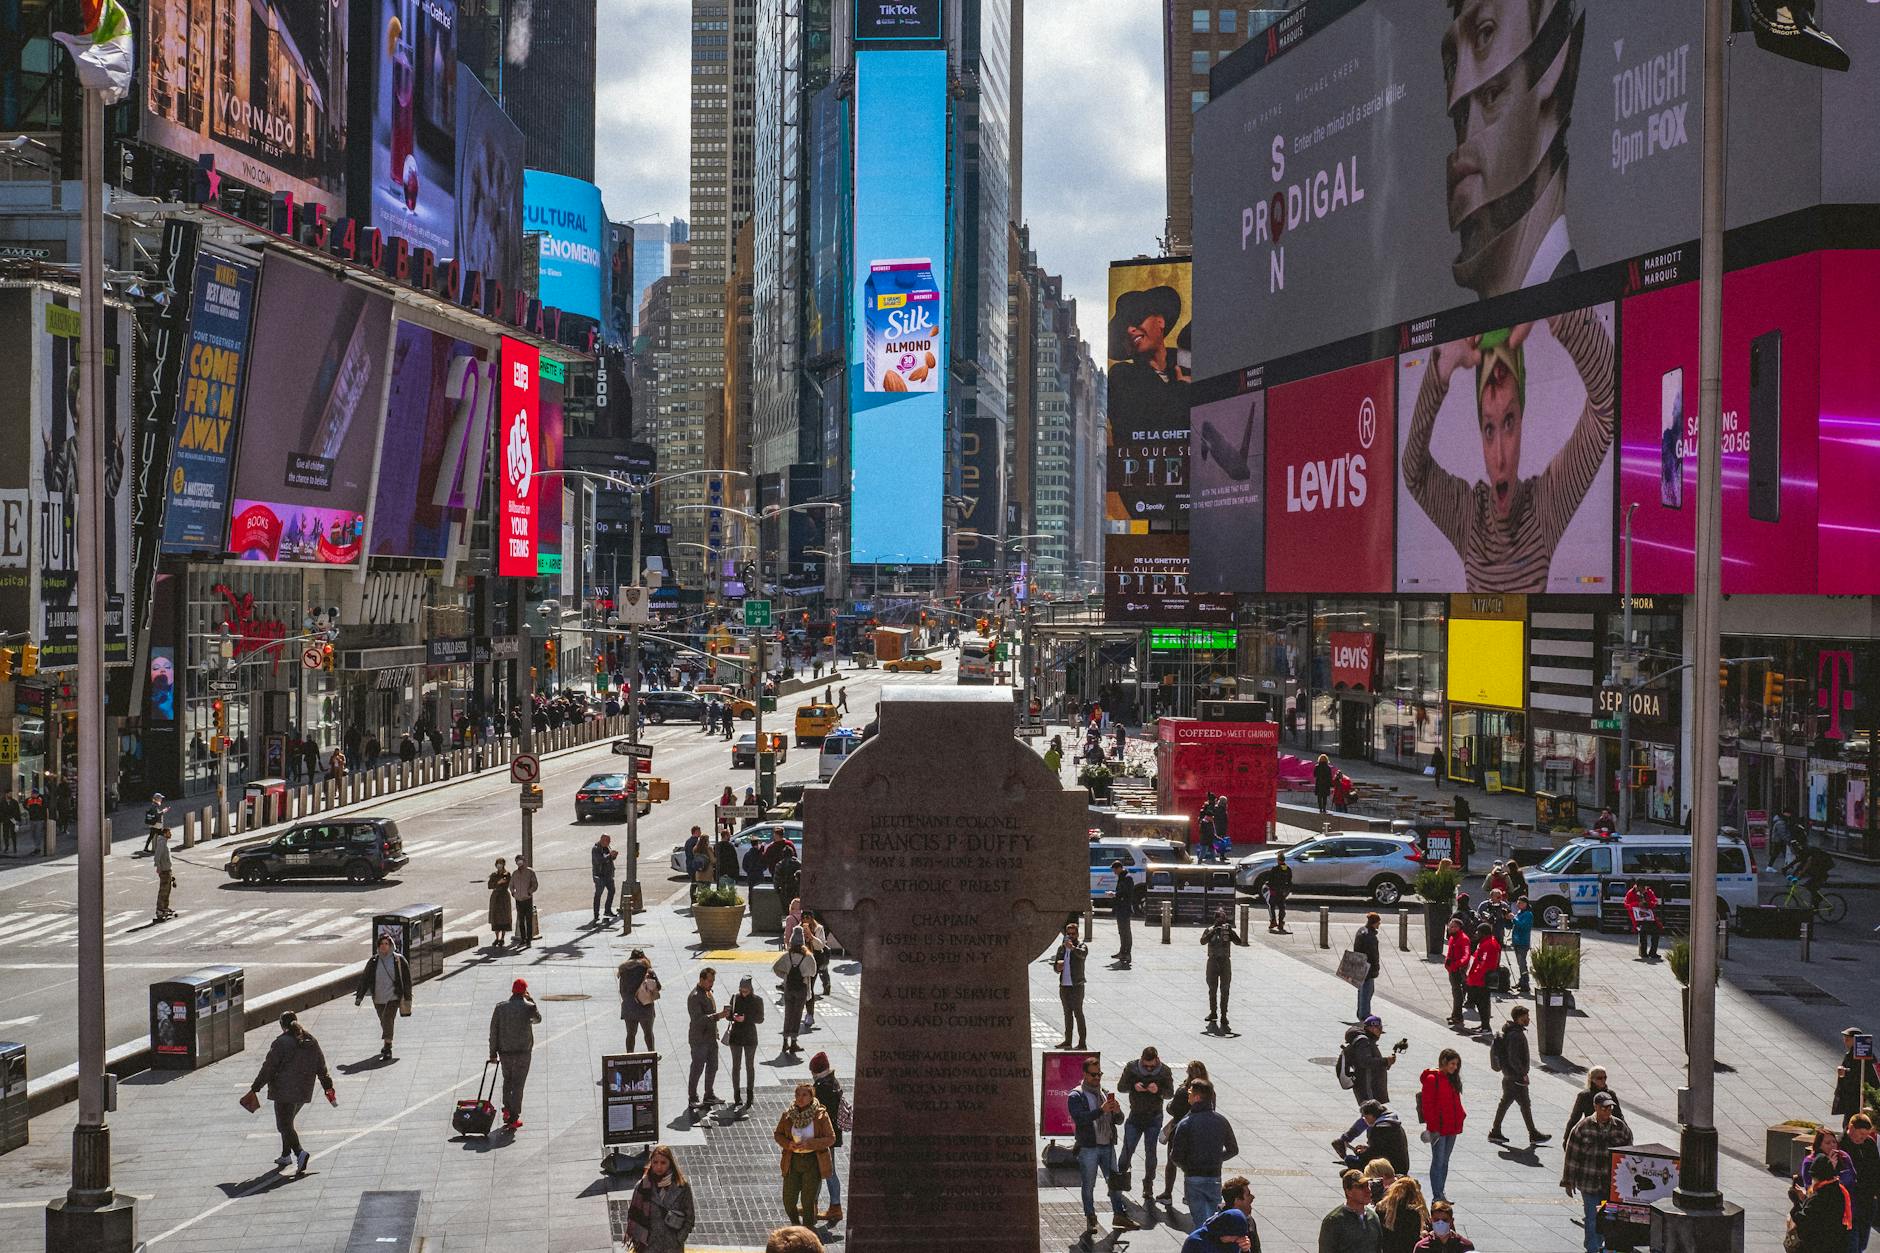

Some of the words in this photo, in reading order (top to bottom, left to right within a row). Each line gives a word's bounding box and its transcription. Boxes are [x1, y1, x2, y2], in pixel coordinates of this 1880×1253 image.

[880, 5, 918, 15] TikTok
[1279, 6, 1306, 33] MARRIOTT
[1279, 25, 1303, 49] MARQUIS
[1332, 57, 1360, 81] SHEEN
[1612, 44, 1689, 122] TONIGHT
[218, 88, 294, 148] VORNADO
[1294, 134, 1313, 155] Enter
[1313, 127, 1325, 145] the
[1326, 115, 1345, 138] mind
[1346, 104, 1357, 126] of
[1362, 95, 1384, 118] serial
[1612, 127, 1643, 175] 9pm
[1648, 101, 1688, 156] FOX
[261, 140, 284, 158] TRUST
[242, 161, 271, 185] VNO.COM
[1242, 155, 1365, 250] PRODIGAL
[271, 191, 383, 269] 1540
[0, 249, 44, 257] AMAR
[1644, 250, 1682, 269] MARRIOTT
[1644, 267, 1678, 286] MARQUIS
[206, 282, 219, 301] BEST
[219, 285, 241, 309] MUSICAL
[884, 305, 934, 340] Silk
[1411, 318, 1436, 333] MARRIOTT
[193, 330, 209, 342] COME
[1411, 331, 1433, 345] MARQUIS
[885, 340, 931, 354] ALMOND
[189, 342, 240, 385] COME
[596, 357, 608, 407] 1500
[1688, 411, 1738, 436] SANG
[179, 415, 232, 454] AWAY
[1132, 430, 1146, 440] DE
[1147, 430, 1161, 440] LA
[1737, 431, 1750, 452] 5G
[1122, 457, 1183, 487] PIE
[1145, 502, 1165, 511] Spotify
[247, 515, 269, 529] BOOKS
[510, 516, 528, 536] YOUR
[509, 539, 529, 558] TERMS
[803, 563, 816, 571] FX
[1621, 598, 1653, 609] SPHORA
[442, 641, 454, 654] POLO
[1600, 690, 1660, 716] SEPORA
[1178, 729, 1223, 738] COFFEED
[1227, 730, 1246, 738] SWEET
[1247, 730, 1275, 738] CHURROS
[2, 736, 10, 759] ATM
[870, 815, 951, 829] LIEUTENANT
[955, 816, 1020, 829] COLONEL
[859, 833, 941, 852] FRANCIS
[967, 834, 1035, 852] DUFFY
[1427, 837, 1451, 849] ERIKA
[868, 856, 894, 868] MAY
[1427, 850, 1451, 860] JAYNE
[880, 879, 953, 893] CATHOLIC
[959, 879, 1010, 893] PRIEST
[911, 914, 979, 927] CHAPLAIN
[950, 934, 1011, 946] INFANTRY
[898, 951, 926, 963] OLD
[897, 987, 926, 1000] LIFE
[931, 986, 948, 1000] OF
[956, 986, 1010, 1000] SERVICE
[934, 1002, 957, 1012] FOR
[876, 1015, 909, 1027] GOD
[912, 1015, 944, 1027] AND
[948, 1015, 1016, 1028] COUNTRY
[924, 1050, 987, 1062] AMERICAN
[990, 1050, 1017, 1062] WAR
[858, 1067, 883, 1078] NEW
[989, 1067, 1032, 1079] GUARD
